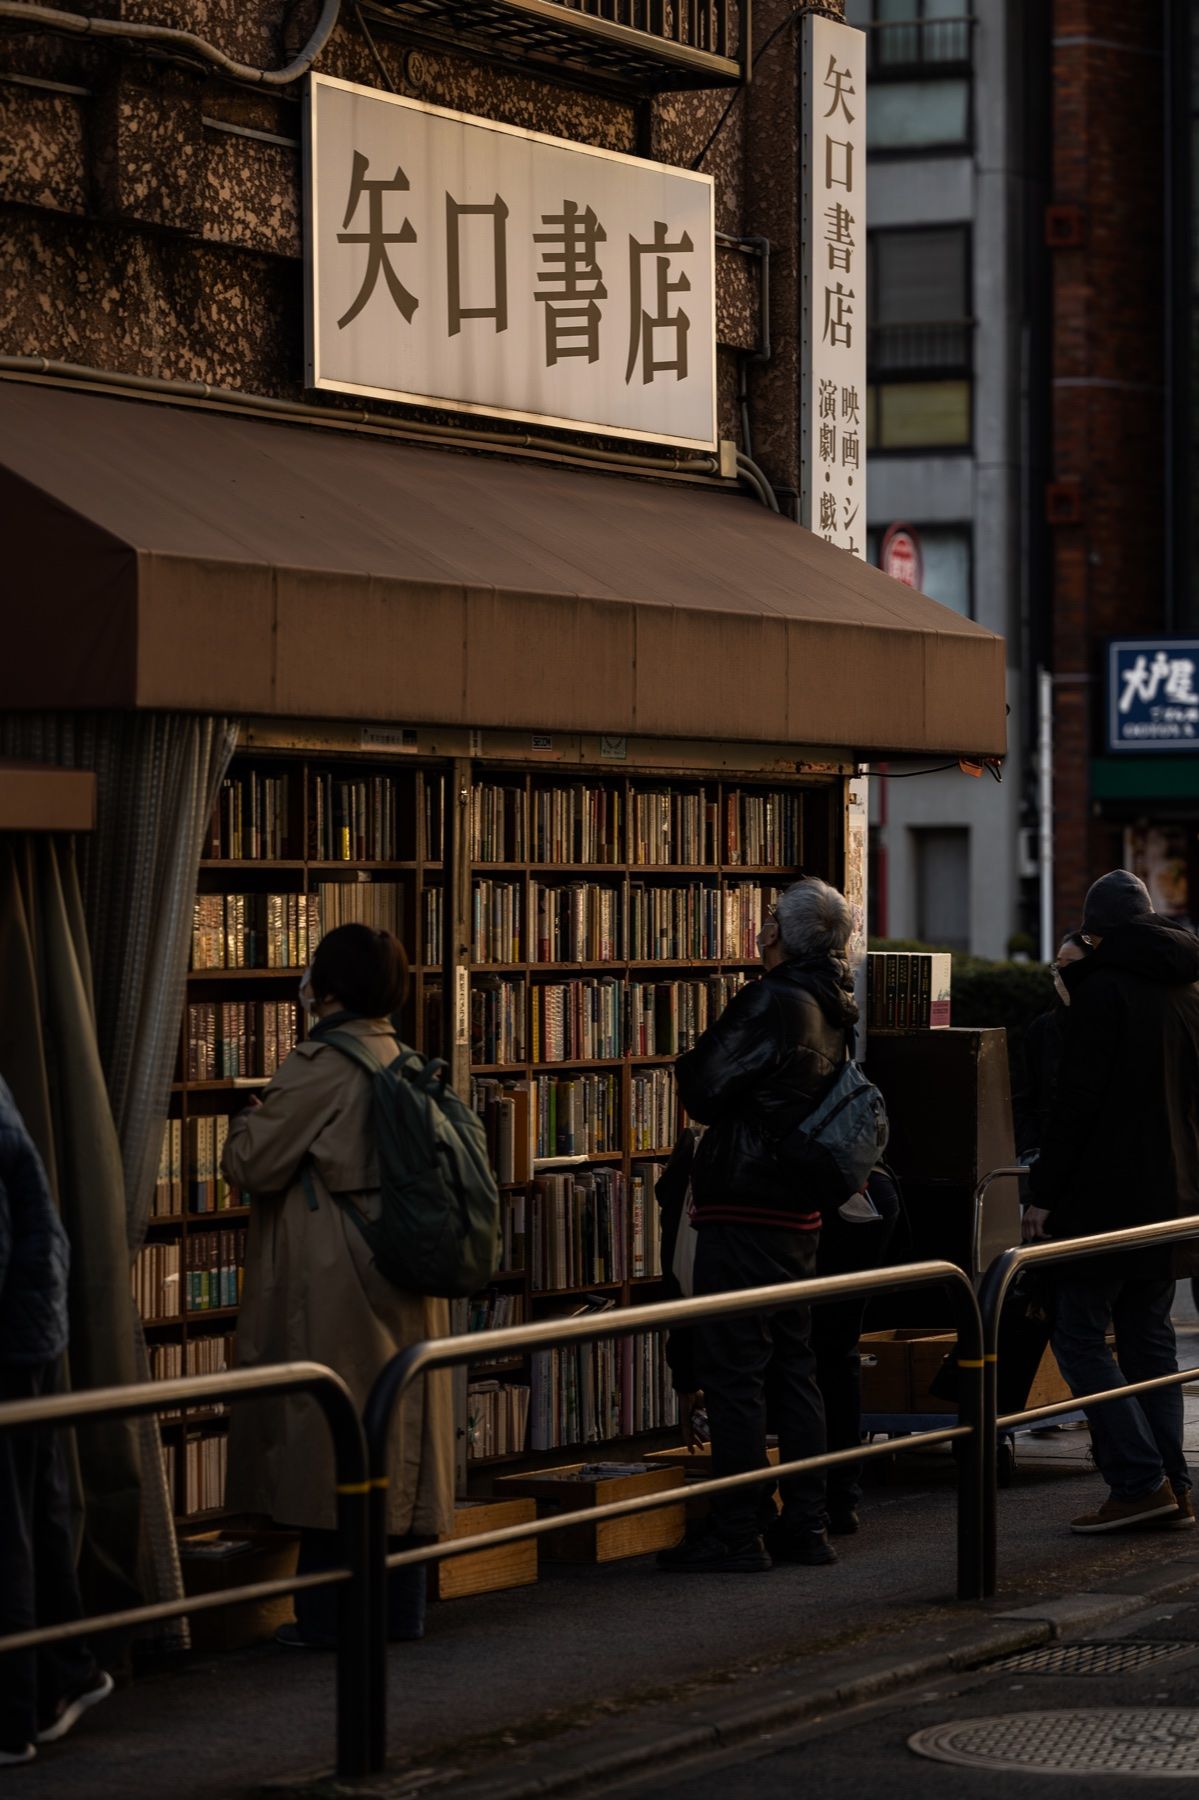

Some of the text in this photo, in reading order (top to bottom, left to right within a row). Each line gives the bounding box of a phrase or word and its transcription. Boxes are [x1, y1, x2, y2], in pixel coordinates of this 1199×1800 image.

[335, 149, 695, 387] 矢口書店
[823, 54, 856, 348] 矢口書店
[818, 378, 838, 543] 演劇・戯
